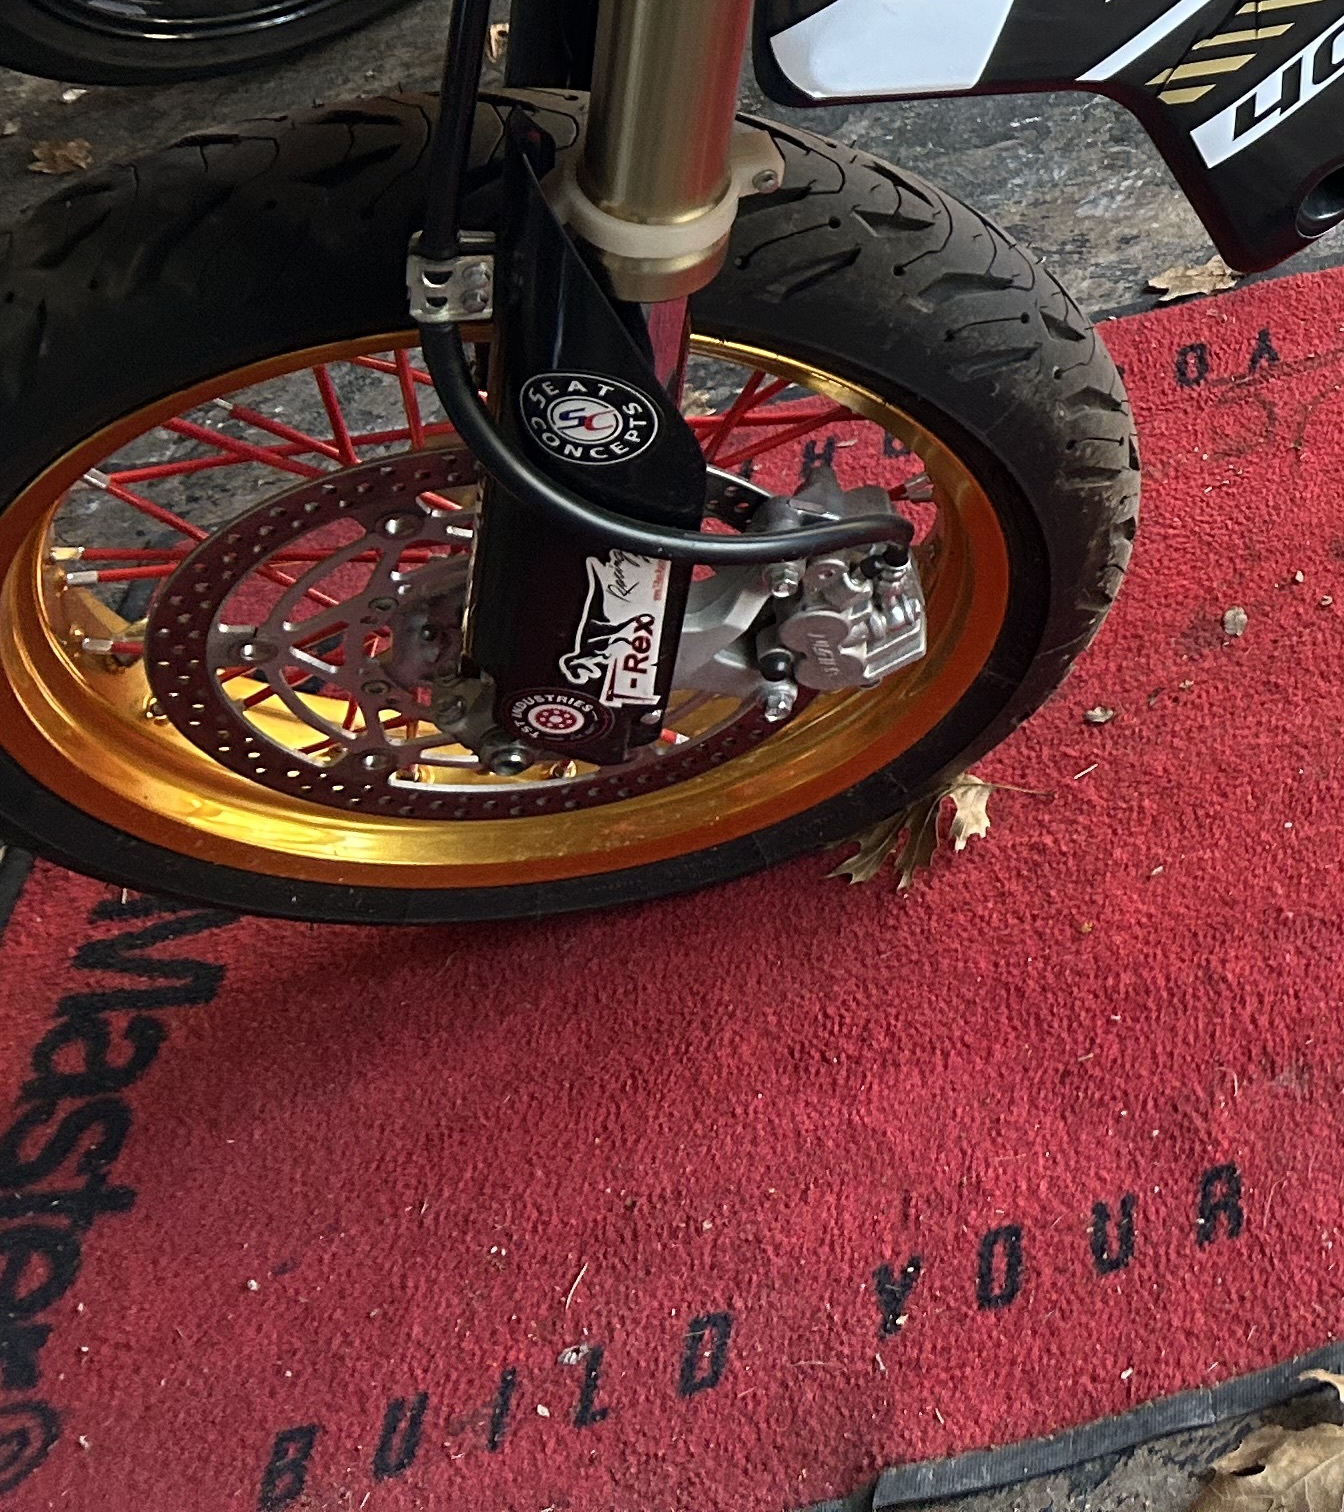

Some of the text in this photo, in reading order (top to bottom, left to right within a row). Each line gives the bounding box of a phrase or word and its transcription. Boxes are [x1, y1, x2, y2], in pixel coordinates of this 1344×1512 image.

[528, 380, 615, 409] SEAT
[530, 402, 648, 460] CONCEPTS
[511, 693, 594, 719] INDUSTRIES
[257, 1311, 733, 1512] BUILD
[872, 1161, 1244, 1340] YOUR
